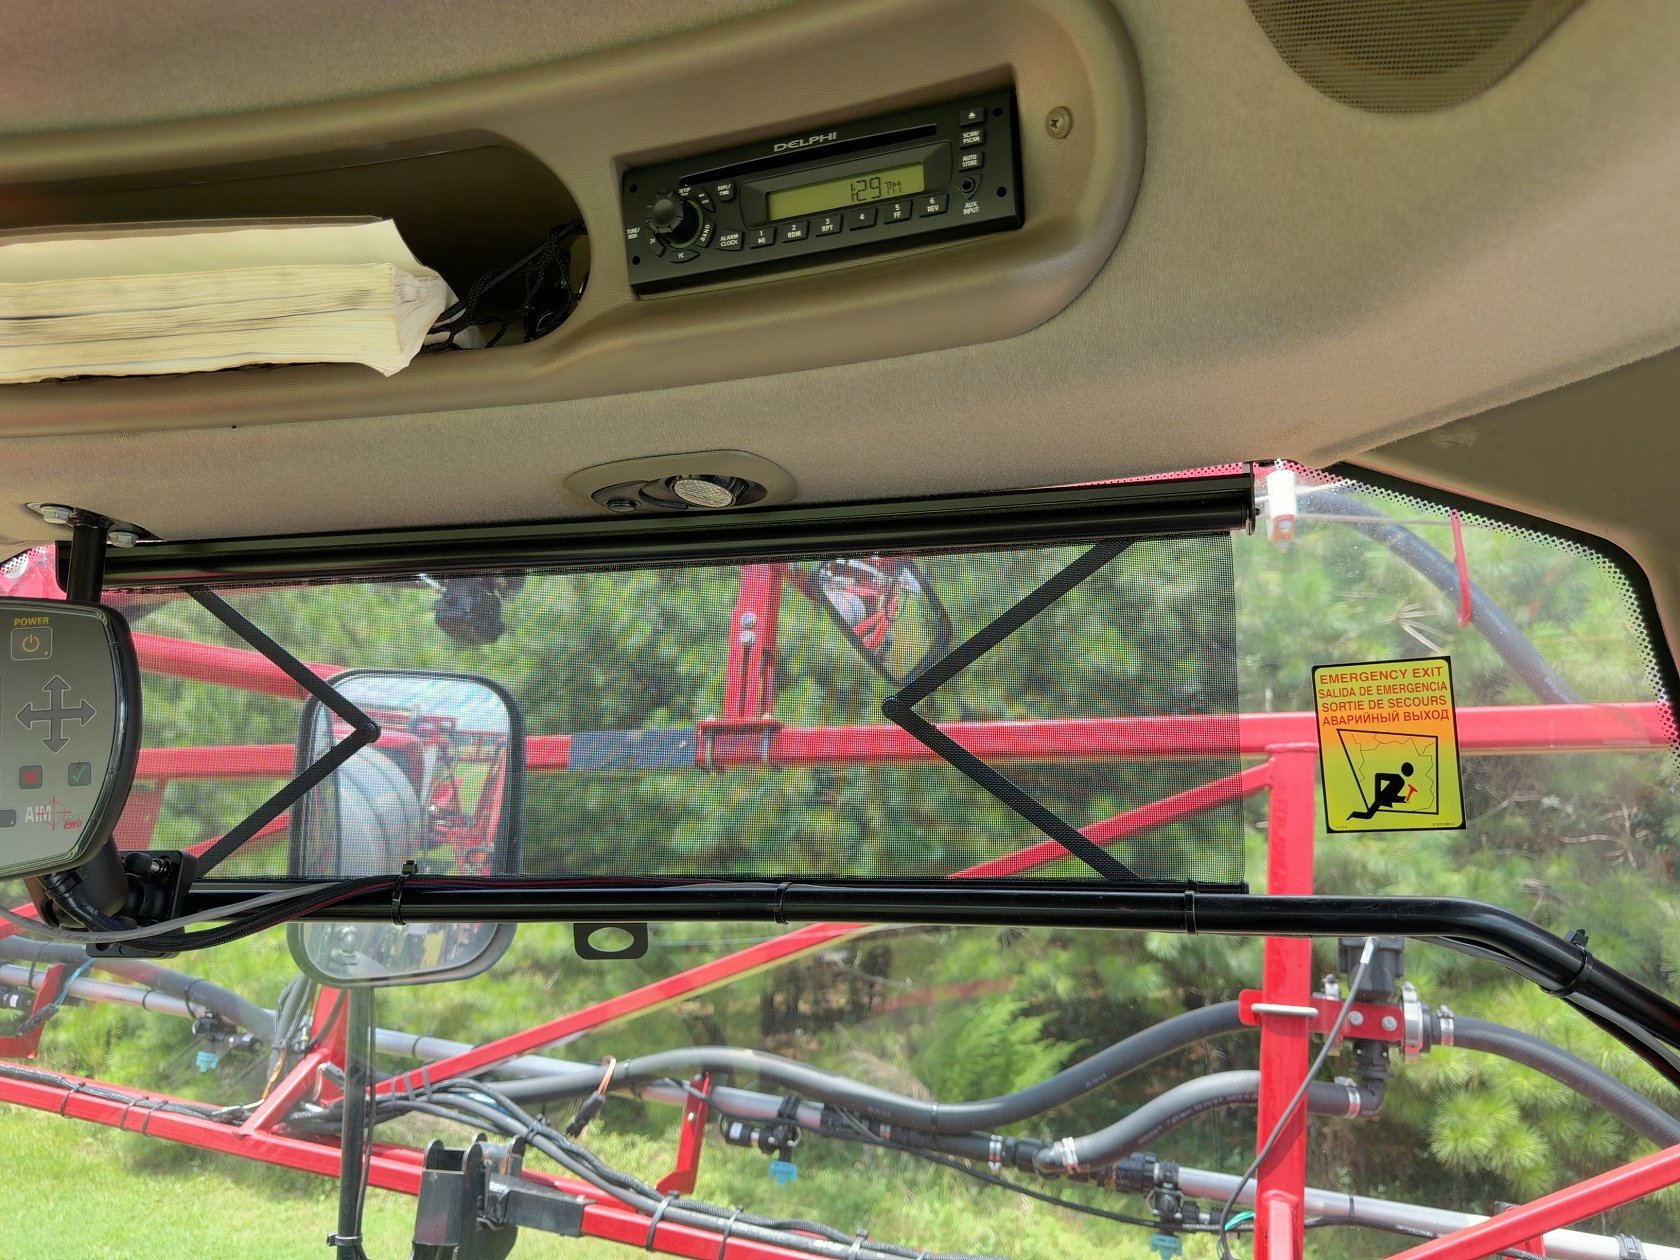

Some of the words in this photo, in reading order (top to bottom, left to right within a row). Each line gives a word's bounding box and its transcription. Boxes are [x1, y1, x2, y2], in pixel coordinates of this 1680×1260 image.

[773, 132, 837, 152] DELPHI
[962, 154, 977, 162] AUTO
[962, 160, 978, 168] STORE
[883, 180, 902, 195] PM
[927, 204, 940, 213] REV
[964, 201, 978, 209] AUX
[893, 211, 902, 219] FF
[963, 206, 980, 215] INPUT
[821, 224, 834, 232] RPT
[700, 224, 711, 242] BAND
[720, 233, 739, 242] ALARM
[787, 230, 802, 238] RDM
[720, 239, 738, 247] CLOCK
[14, 616, 49, 627] POWER
[1319, 669, 1408, 684] EMERGENCY
[1412, 666, 1443, 679] EXIT
[1318, 687, 1356, 699] SALIDA
[1359, 685, 1374, 697] DE
[1376, 681, 1448, 695] EMERGENCIA
[1321, 700, 1365, 713] SORTIE
[1368, 698, 1385, 710] DE
[1388, 695, 1447, 709] SECOURS
[1322, 711, 1400, 727] АВАРИЙНЫЙ
[1403, 709, 1450, 722] ВЫХОД
[24, 805, 52, 824] AIM
[63, 820, 84, 830] PRO
